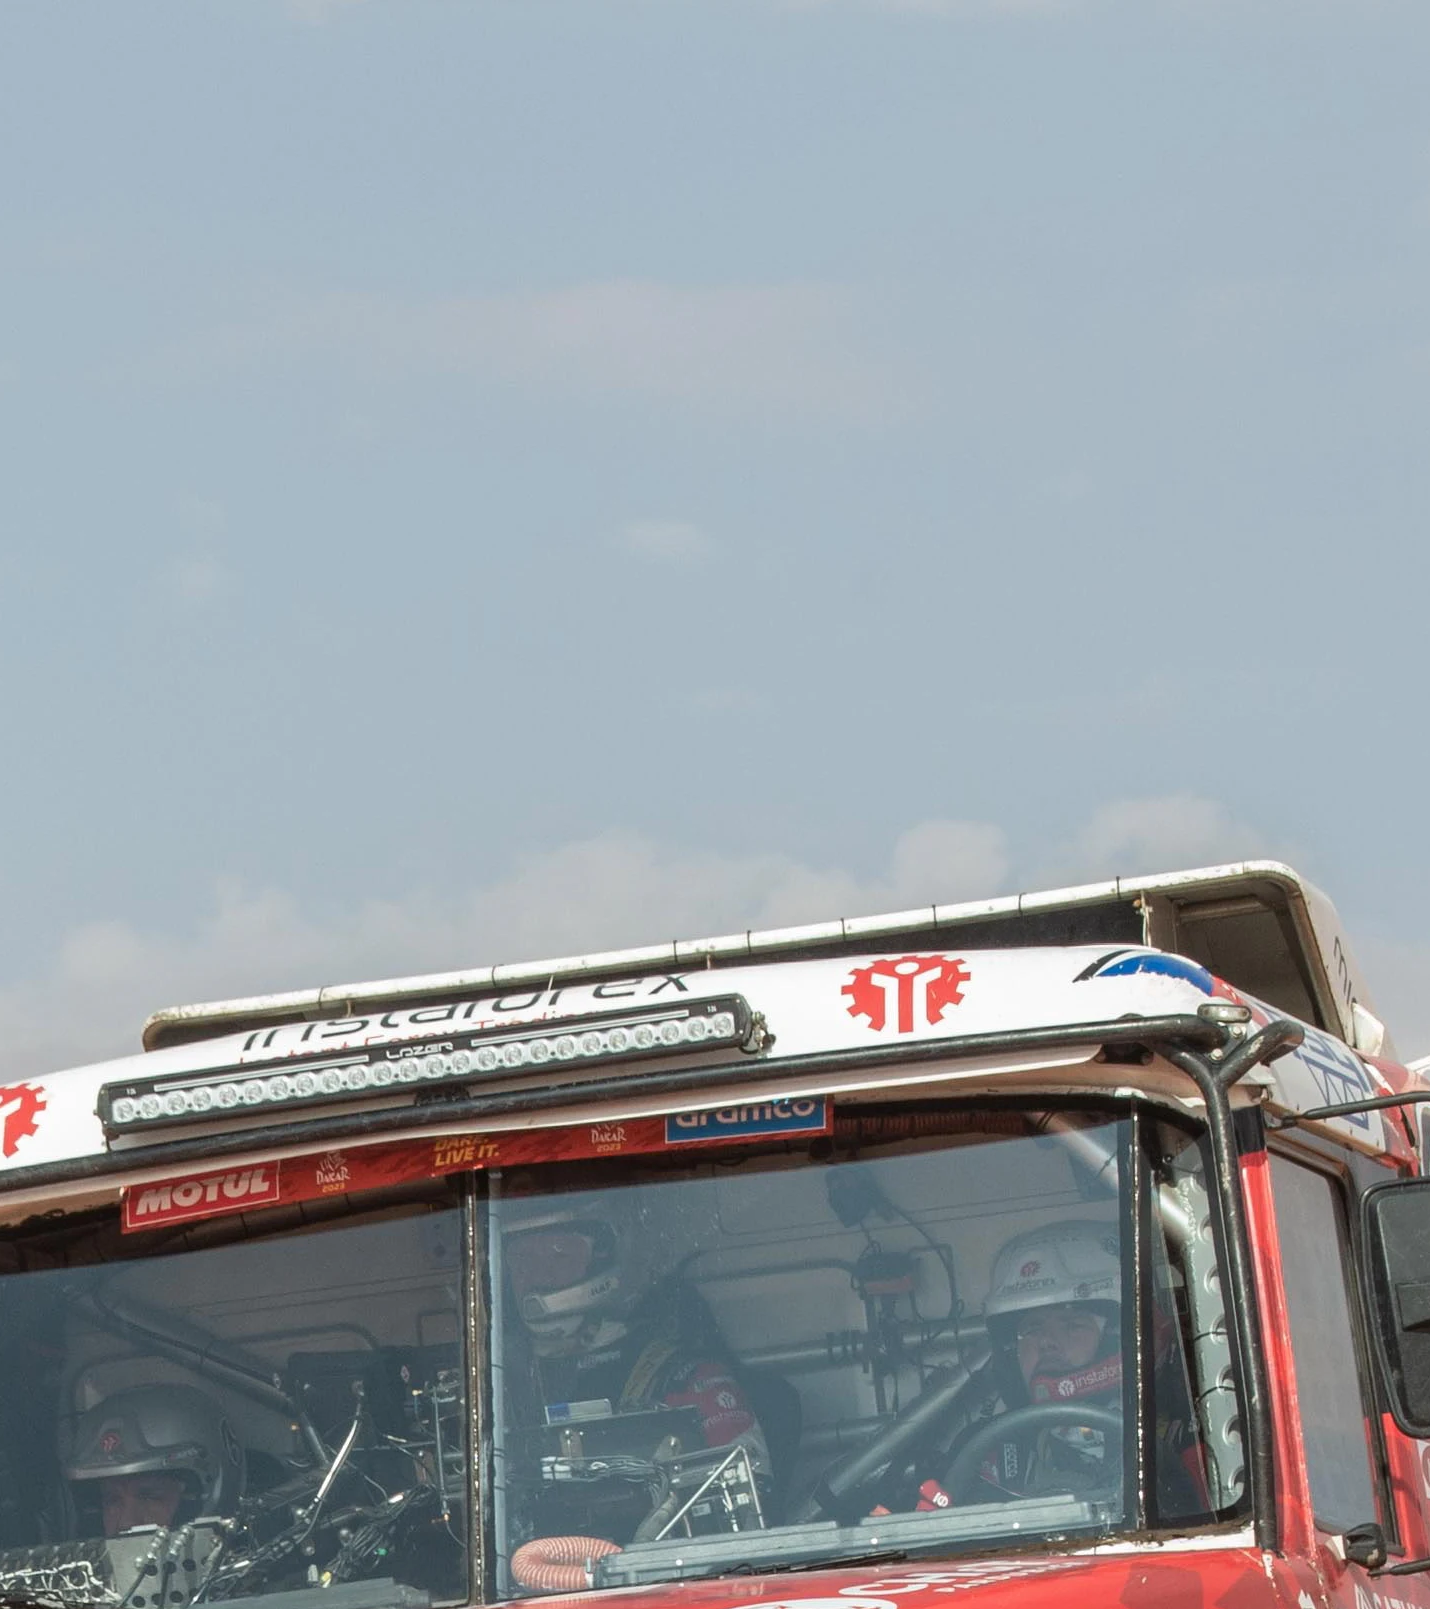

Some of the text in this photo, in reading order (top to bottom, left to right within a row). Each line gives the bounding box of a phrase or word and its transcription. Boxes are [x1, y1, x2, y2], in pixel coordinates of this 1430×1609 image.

[676, 1098, 816, 1126] aramco
[591, 1127, 627, 1143] DAKAR
[435, 1144, 499, 1166] LIVE IT.
[316, 1169, 351, 1186] DAKAR
[136, 1167, 271, 1215] MOTUL
